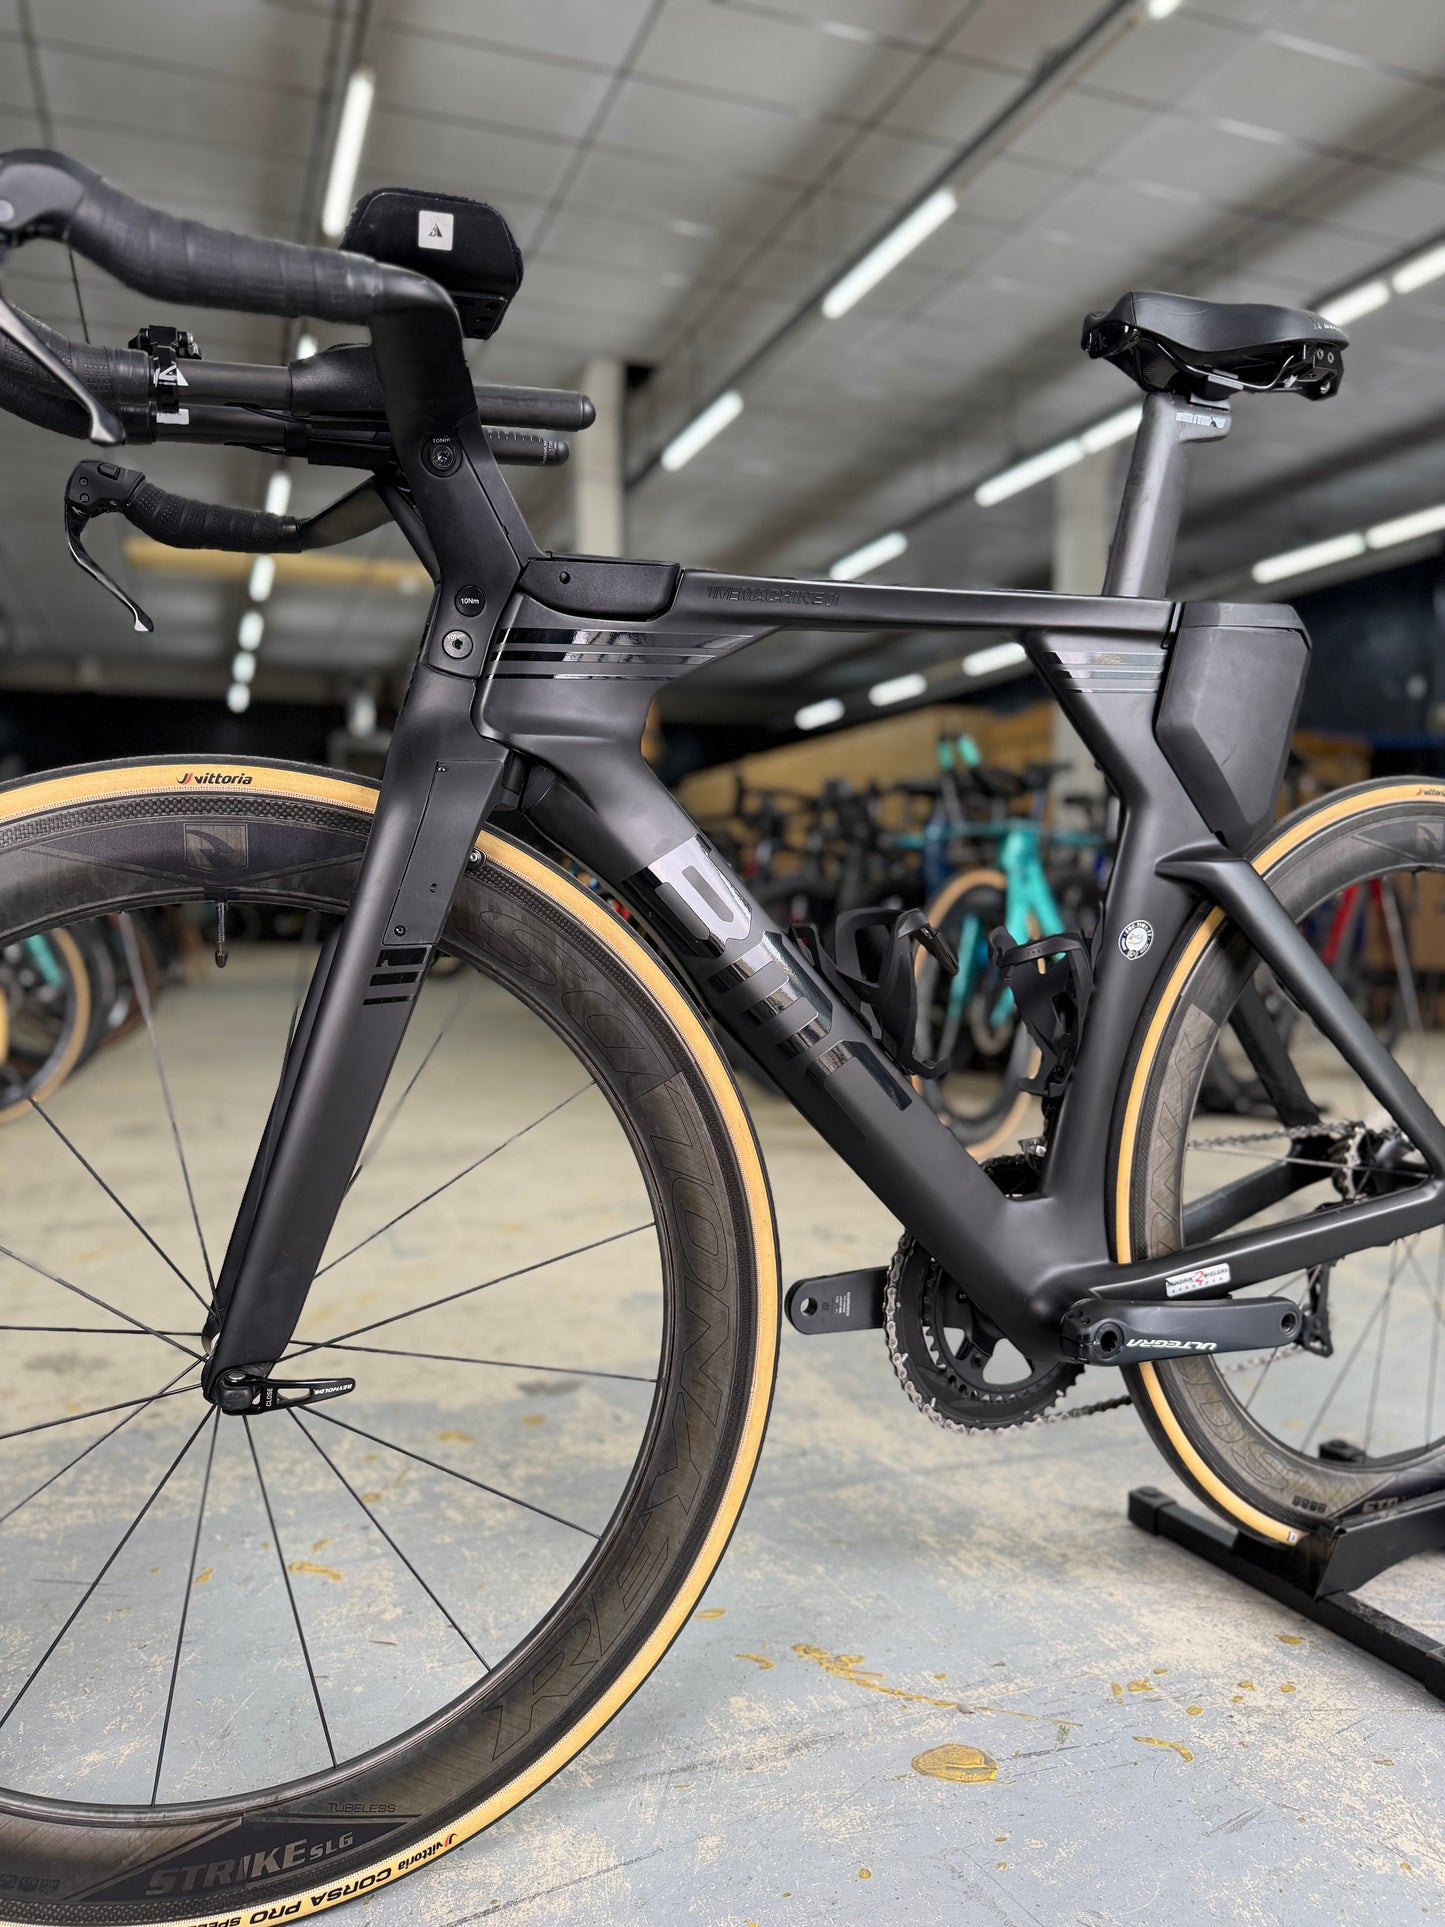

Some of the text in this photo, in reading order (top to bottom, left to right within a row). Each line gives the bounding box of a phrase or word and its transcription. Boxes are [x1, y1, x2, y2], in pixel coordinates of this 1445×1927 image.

[460, 597, 480, 605] 10Nm
[194, 773, 253, 785] vittoria
[1126, 1338, 1217, 1350] ULTEGRA
[265, 1387, 274, 1407] CLOSE
[313, 1383, 353, 1395] REYNOLDS
[328, 1802, 396, 1813] TUBELESS
[145, 1831, 353, 1896] STRIKE SLG
[398, 1840, 444, 1871] vittoria
[311, 1868, 392, 1907] CORSA
[250, 1901, 302, 1927] PRO
